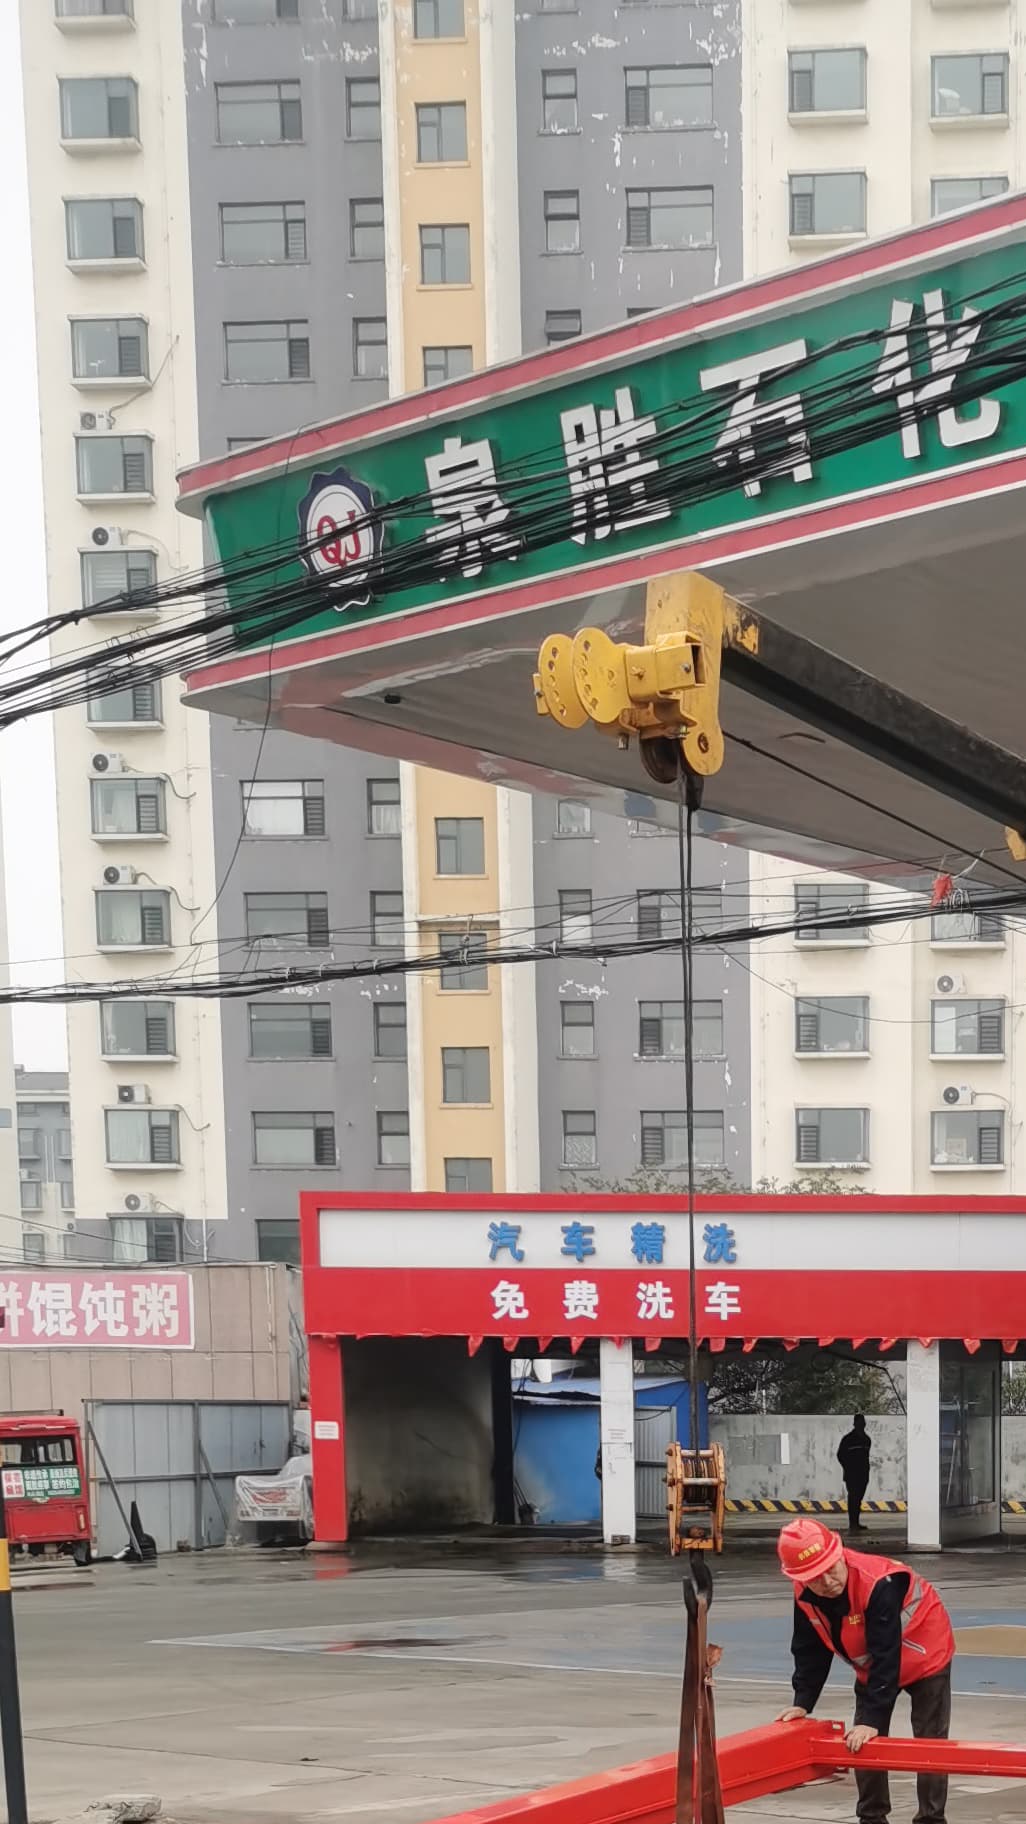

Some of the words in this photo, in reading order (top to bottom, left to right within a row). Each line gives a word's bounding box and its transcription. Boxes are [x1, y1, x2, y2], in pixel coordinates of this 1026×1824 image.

[425, 289, 1001, 579] 泉胜石化
[317, 509, 361, 568] QJ
[488, 1221, 738, 1264] 汽车精洗
[490, 1280, 741, 1320] 免费洗车
